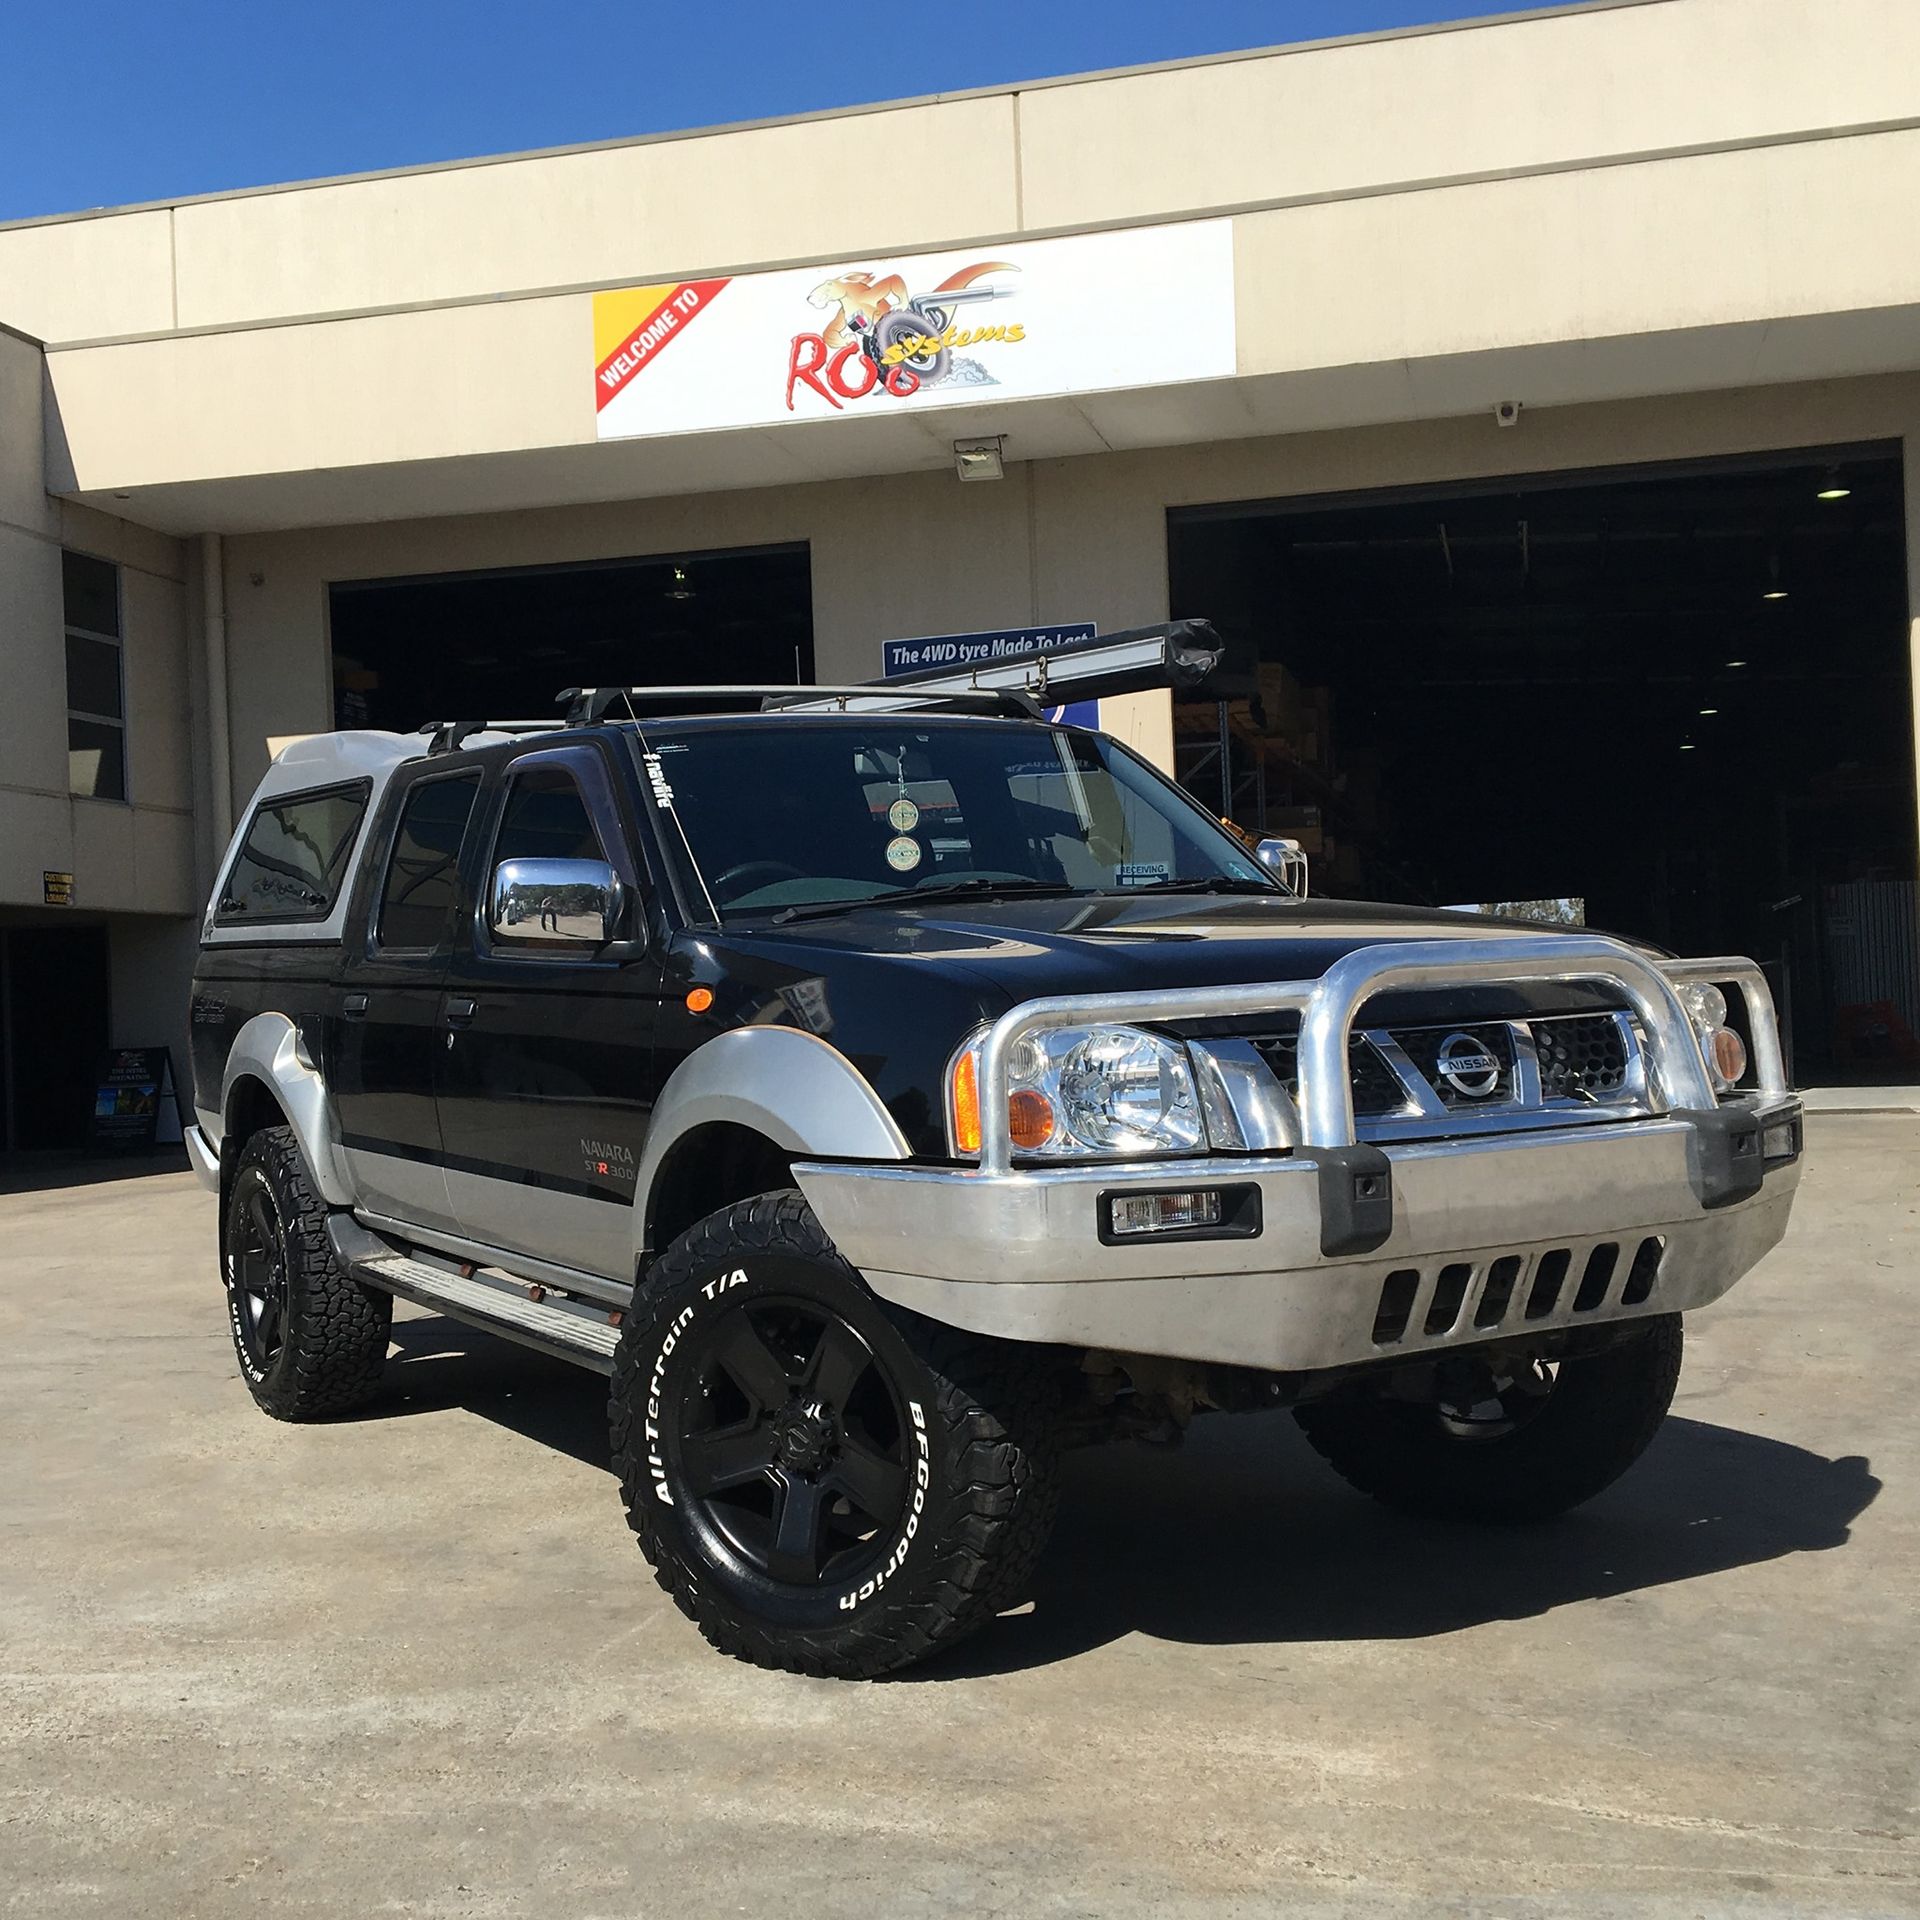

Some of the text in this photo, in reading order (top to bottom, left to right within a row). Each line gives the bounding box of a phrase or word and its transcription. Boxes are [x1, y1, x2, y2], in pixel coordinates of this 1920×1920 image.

[599, 288, 699, 388] WELCOME TO
[892, 648, 919, 665] The
[921, 643, 957, 663] 4WD
[958, 643, 989, 663] tyre
[991, 636, 1032, 656] Made
[1036, 635, 1053, 649] To
[1121, 865, 1165, 874] RECEIVING
[1448, 1057, 1496, 1071] NISSAN
[580, 1138, 634, 1165] NAVARA
[645, 1268, 749, 1506] All-Terrain T/A
[839, 1400, 930, 1611] BFGoodrich
